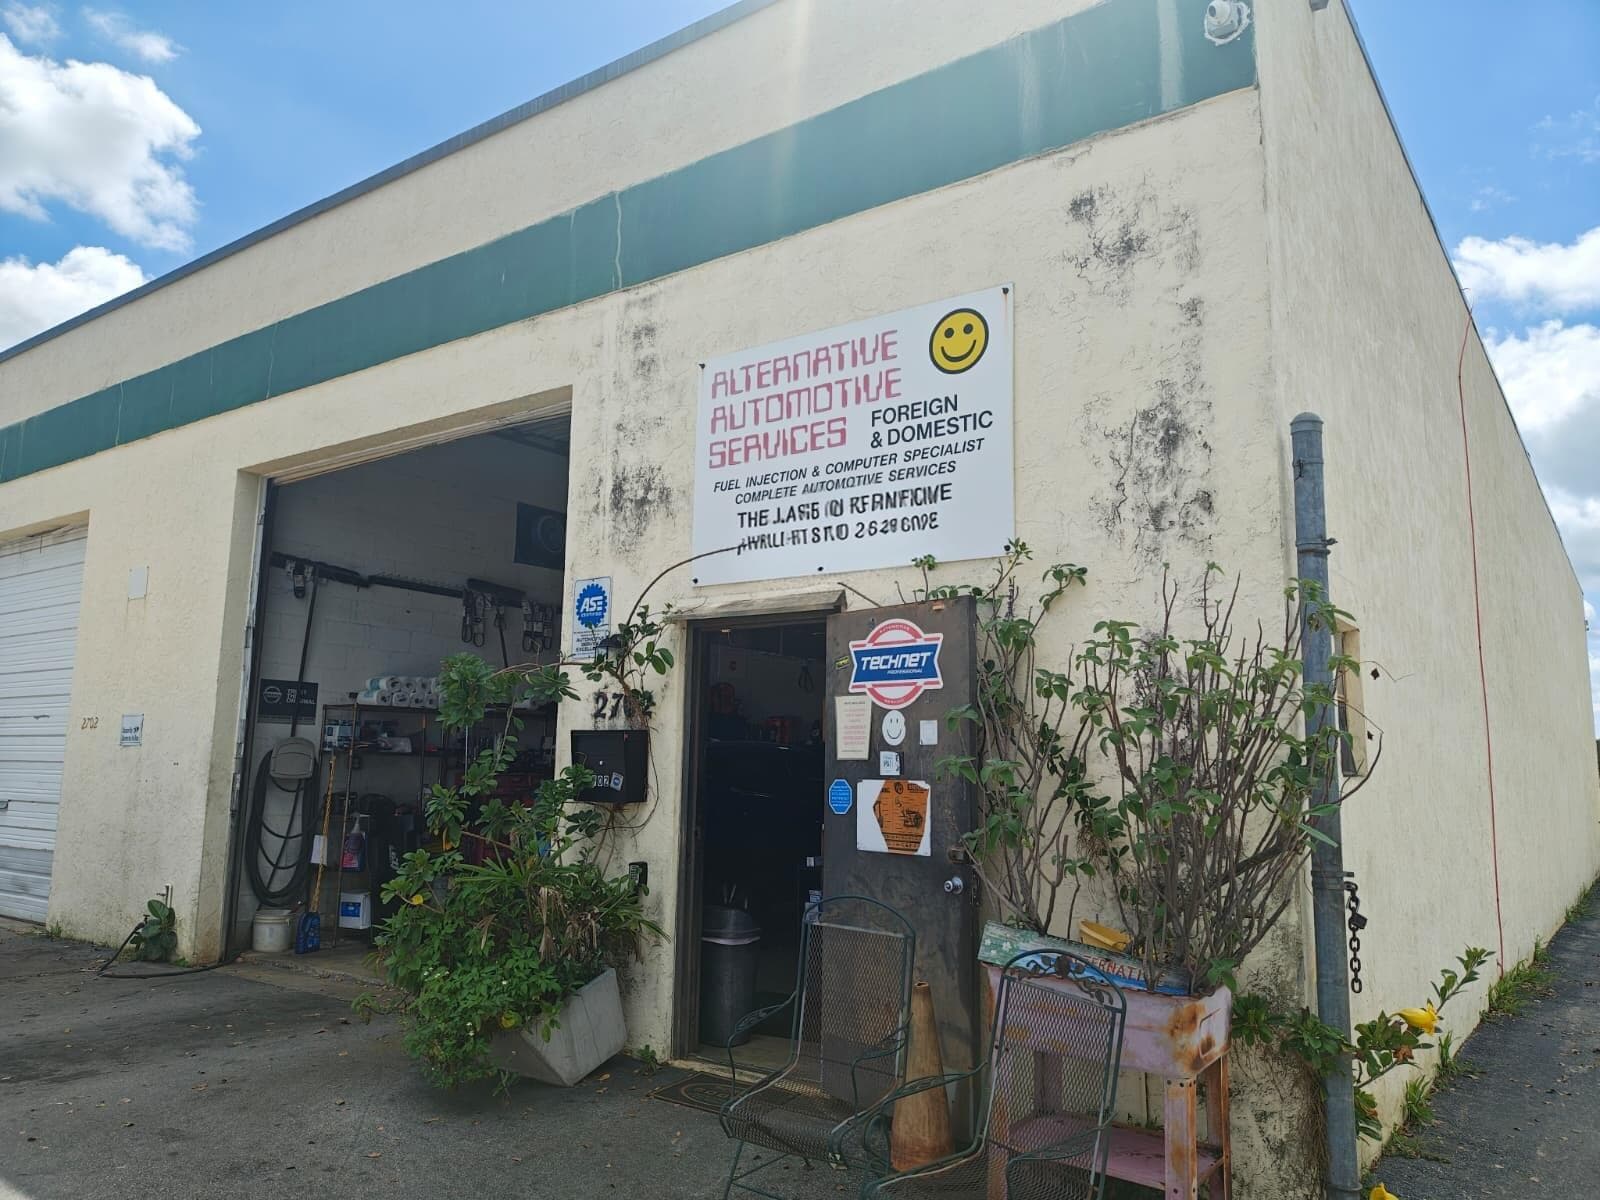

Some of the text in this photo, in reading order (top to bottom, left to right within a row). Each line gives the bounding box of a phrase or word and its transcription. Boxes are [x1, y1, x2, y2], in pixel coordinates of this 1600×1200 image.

[711, 329, 898, 400] ALTERNATIVE
[710, 367, 902, 435] AUTOMOTIVE
[871, 393, 958, 428] FOREIGN
[708, 416, 847, 469] SERVICES
[870, 410, 993, 449] & DOMESTIC
[713, 437, 985, 493] FUEL INJECTION & COMPUTER SPECIALIST
[735, 460, 957, 505] COMPLETE AUTOMOTIVE SERVICES
[736, 508, 770, 529] THE
[580, 595, 604, 612] ASE
